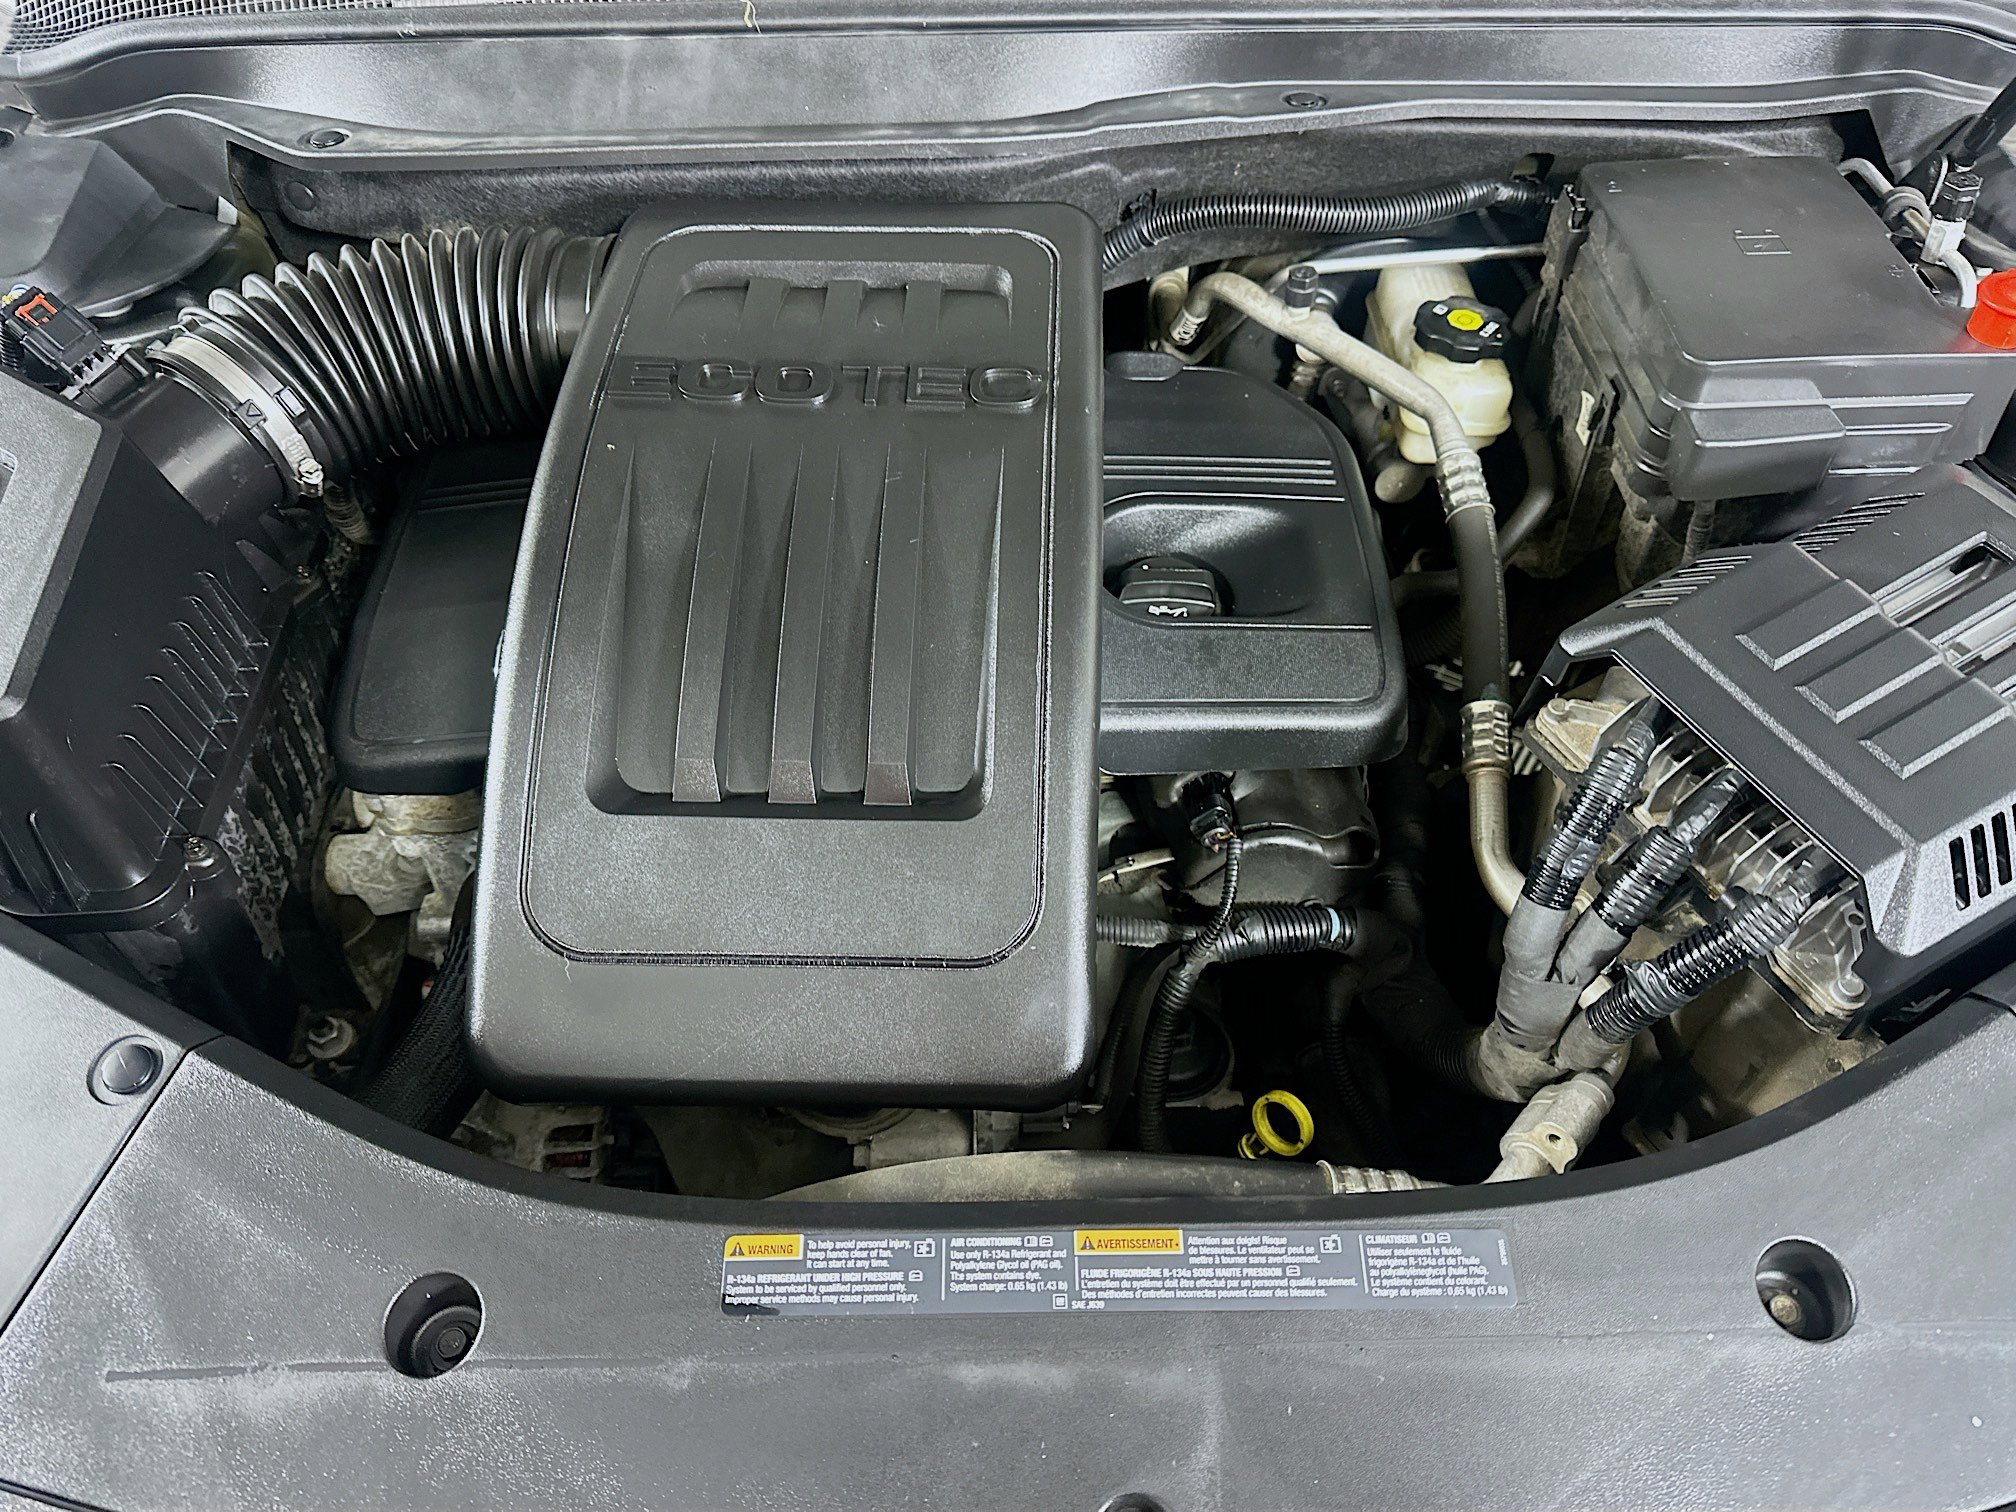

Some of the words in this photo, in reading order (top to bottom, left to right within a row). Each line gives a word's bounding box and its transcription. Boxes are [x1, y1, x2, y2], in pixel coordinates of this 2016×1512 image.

[606, 356, 1044, 410] ECOTEC
[807, 1240, 816, 1249] To
[818, 1240, 834, 1250] help
[835, 1240, 855, 1248] avoid
[856, 1239, 887, 1249] personal
[950, 1238, 964, 1247] AIR
[966, 1237, 1022, 1247] CONDITIONING
[1097, 1239, 1174, 1248] AVERTISSEMENT
[1188, 1236, 1220, 1245] Attention
[1236, 1236, 1261, 1246] doigts!
[1262, 1236, 1287, 1245] Risque
[1365, 1234, 1418, 1244] CLIMATISEUR
[748, 1245, 793, 1254] WARNING
[807, 1251, 825, 1259] keep
[827, 1250, 849, 1258] hands
[850, 1250, 868, 1258] clear
[879, 1249, 893, 1257] fan.
[951, 1251, 964, 1259] Use
[966, 1250, 981, 1260] only
[983, 1250, 1010, 1259] R-134a
[1011, 1249, 1051, 1260] Refrigerant
[1053, 1249, 1067, 1258] and
[1188, 1246, 1198, 1254] de
[1199, 1246, 1236, 1254] blessures.
[1237, 1246, 1247, 1254] Le
[1248, 1246, 1286, 1254] ventilateur
[1288, 1246, 1304, 1255] peut
[1367, 1248, 1393, 1256] Utiliser
[1394, 1247, 1431, 1256] seulement
[1433, 1247, 1440, 1255] le
[1442, 1247, 1462, 1255] fluide
[829, 1259, 845, 1267] start
[847, 1259, 855, 1267] at
[856, 1260, 869, 1269] any
[871, 1259, 890, 1267] time.
[951, 1261, 995, 1271] Polyalkylene
[997, 1260, 1019, 1270] Glycol
[1020, 1260, 1029, 1269] oil
[1031, 1260, 1048, 1270] (PAG
[1049, 1260, 1063, 1270] oil).
[1189, 1256, 1213, 1264] mettre
[1215, 1256, 1220, 1264] à
[1221, 1256, 1247, 1264] tourner
[1368, 1258, 1407, 1267] frigorigène
[1409, 1257, 1436, 1266] R-134a
[1438, 1257, 1445, 1265] et
[1447, 1256, 1456, 1265] de
[966, 1272, 992, 1282] system
[994, 1271, 1024, 1280] contains
[1026, 1271, 1041, 1281] dye.
[1081, 1269, 1108, 1278] FLUIDE
[1110, 1267, 1162, 1278] FRIGORIGÈNE
[1163, 1269, 1191, 1277] R-134a
[1193, 1268, 1214, 1277] SOUS
[1215, 1268, 1241, 1277] HAUTE
[1243, 1268, 1282, 1276] PRESSION
[1370, 1268, 1379, 1276] au
[1448, 1266, 1467, 1276] (huile
[727, 1274, 756, 1283] R-134a
[757, 1274, 812, 1282] REFRIGERANT
[813, 1273, 840, 1281] UNDER
[842, 1273, 861, 1281] HIGH
[862, 1272, 904, 1281] PRESSURE
[1081, 1280, 1120, 1288] L'entretien
[1121, 1279, 1131, 1288] du
[1132, 1280, 1162, 1289] système
[1164, 1279, 1178, 1287] doit
[1180, 1279, 1194, 1287] être
[1196, 1279, 1226, 1287] effectué
[1227, 1280, 1239, 1289] par
[1252, 1278, 1288, 1288] personnel
[1289, 1277, 1316, 1287] qualifié
[1317, 1277, 1358, 1286] seulement.
[1371, 1278, 1380, 1286] Le
[1382, 1278, 1412, 1288] système
[1414, 1277, 1443, 1286] contient
[1445, 1277, 1455, 1285] du
[1456, 1276, 1488, 1285] colorant.
[726, 1285, 754, 1295] System
[756, 1285, 762, 1293] to
[764, 1285, 774, 1293] be
[776, 1284, 806, 1293] serviced
[808, 1284, 817, 1293] by
[819, 1284, 850, 1293] qualified
[852, 1283, 888, 1293] personnel
[889, 1283, 907, 1293] only.
[950, 1282, 977, 1293] System
[979, 1282, 1006, 1292] charge:
[1008, 1282, 1025, 1290] 0.65
[1026, 1281, 1036, 1292] kg
[1037, 1281, 1056, 1291] (1.43
[1058, 1281, 1068, 1291] lb)
[1372, 1288, 1398, 1298] Charge
[1400, 1288, 1410, 1296] du
[1411, 1288, 1442, 1297] système
[1466, 1287, 1476, 1297] kg
[1498, 1286, 1508, 1296] lb)
[725, 1296, 759, 1305] Improper
[789, 1295, 820, 1303] methods
[822, 1296, 838, 1304] may
[863, 1294, 895, 1303] personal
[896, 1293, 919, 1303] injury.
[1082, 1290, 1096, 1299] Des
[1098, 1290, 1133, 1298] méthodes
[1135, 1290, 1174, 1298] d'entretien
[1176, 1289, 1216, 1298] incorrectes
[1218, 1289, 1247, 1299] peuvent
[1275, 1288, 1288, 1297] des
[1290, 1288, 1327, 1297] blessures.
[1072, 1301, 1086, 1309] SAE
